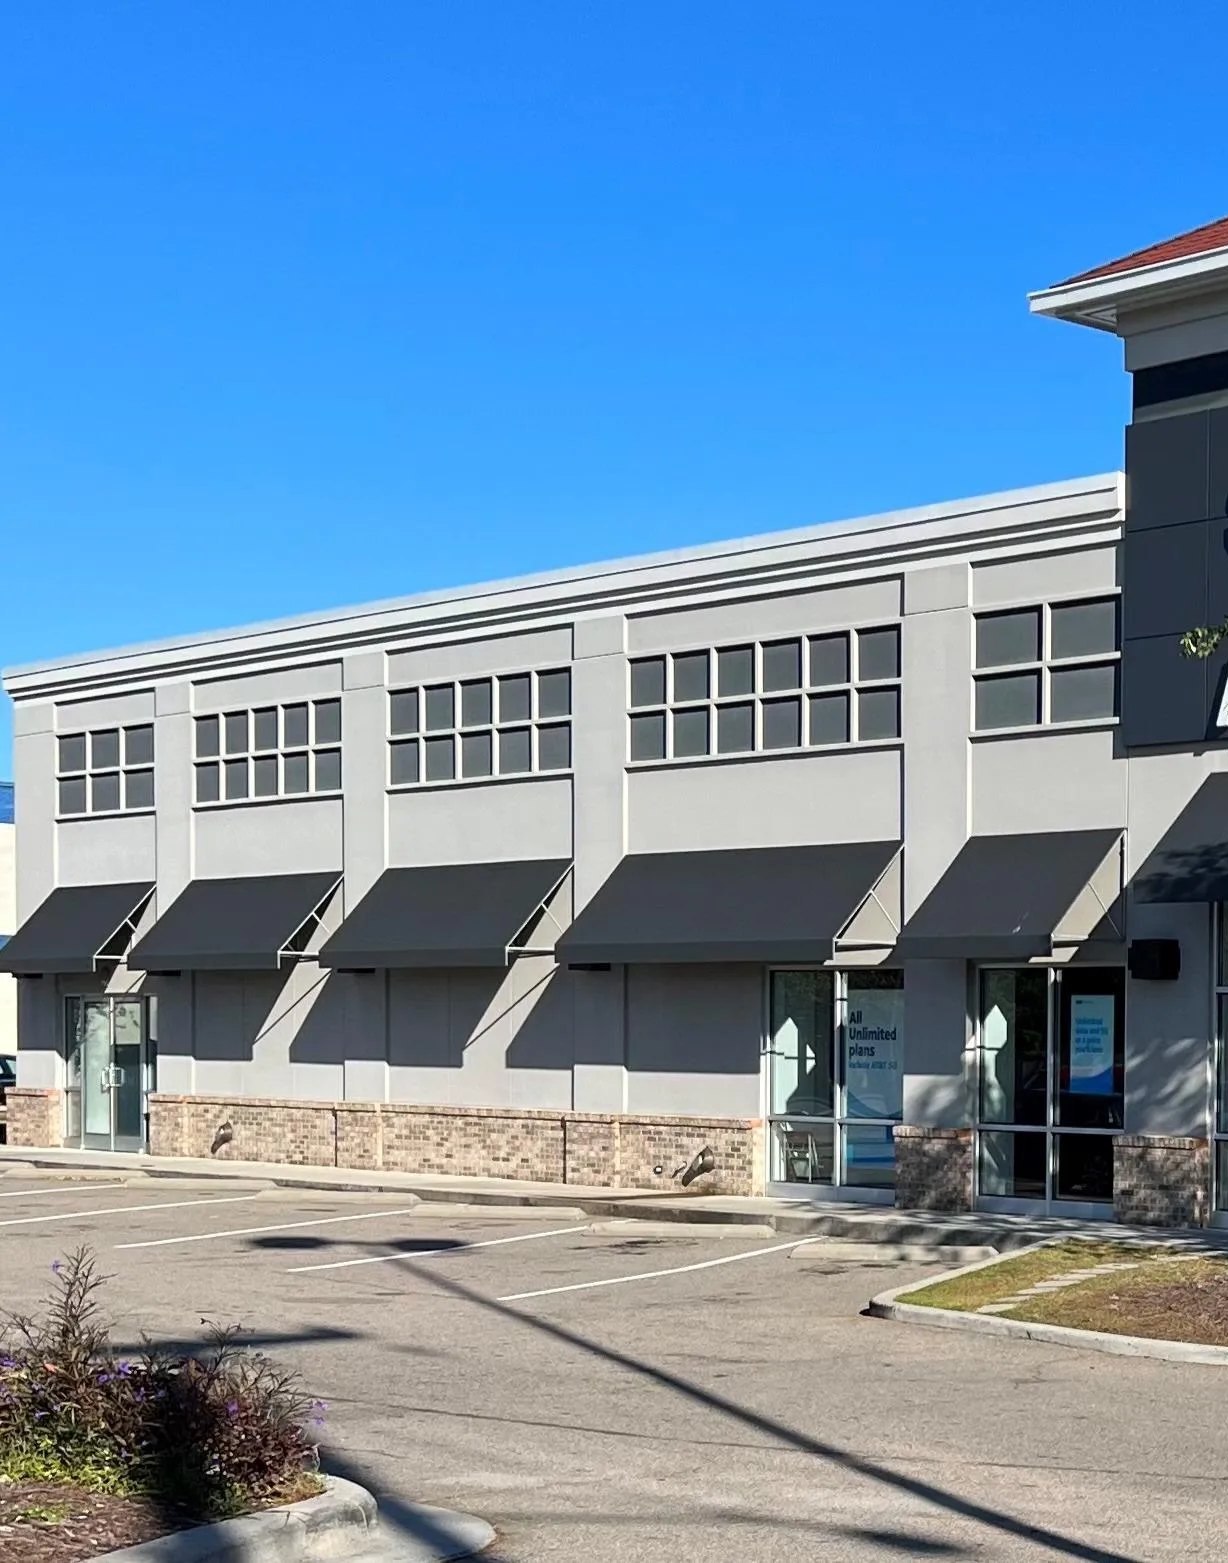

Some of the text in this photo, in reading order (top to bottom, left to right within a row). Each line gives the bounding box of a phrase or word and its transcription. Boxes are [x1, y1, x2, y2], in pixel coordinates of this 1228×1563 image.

[849, 1010, 863, 1024] All
[849, 1027, 897, 1041] Unlimited
[848, 1043, 876, 1060] plans
